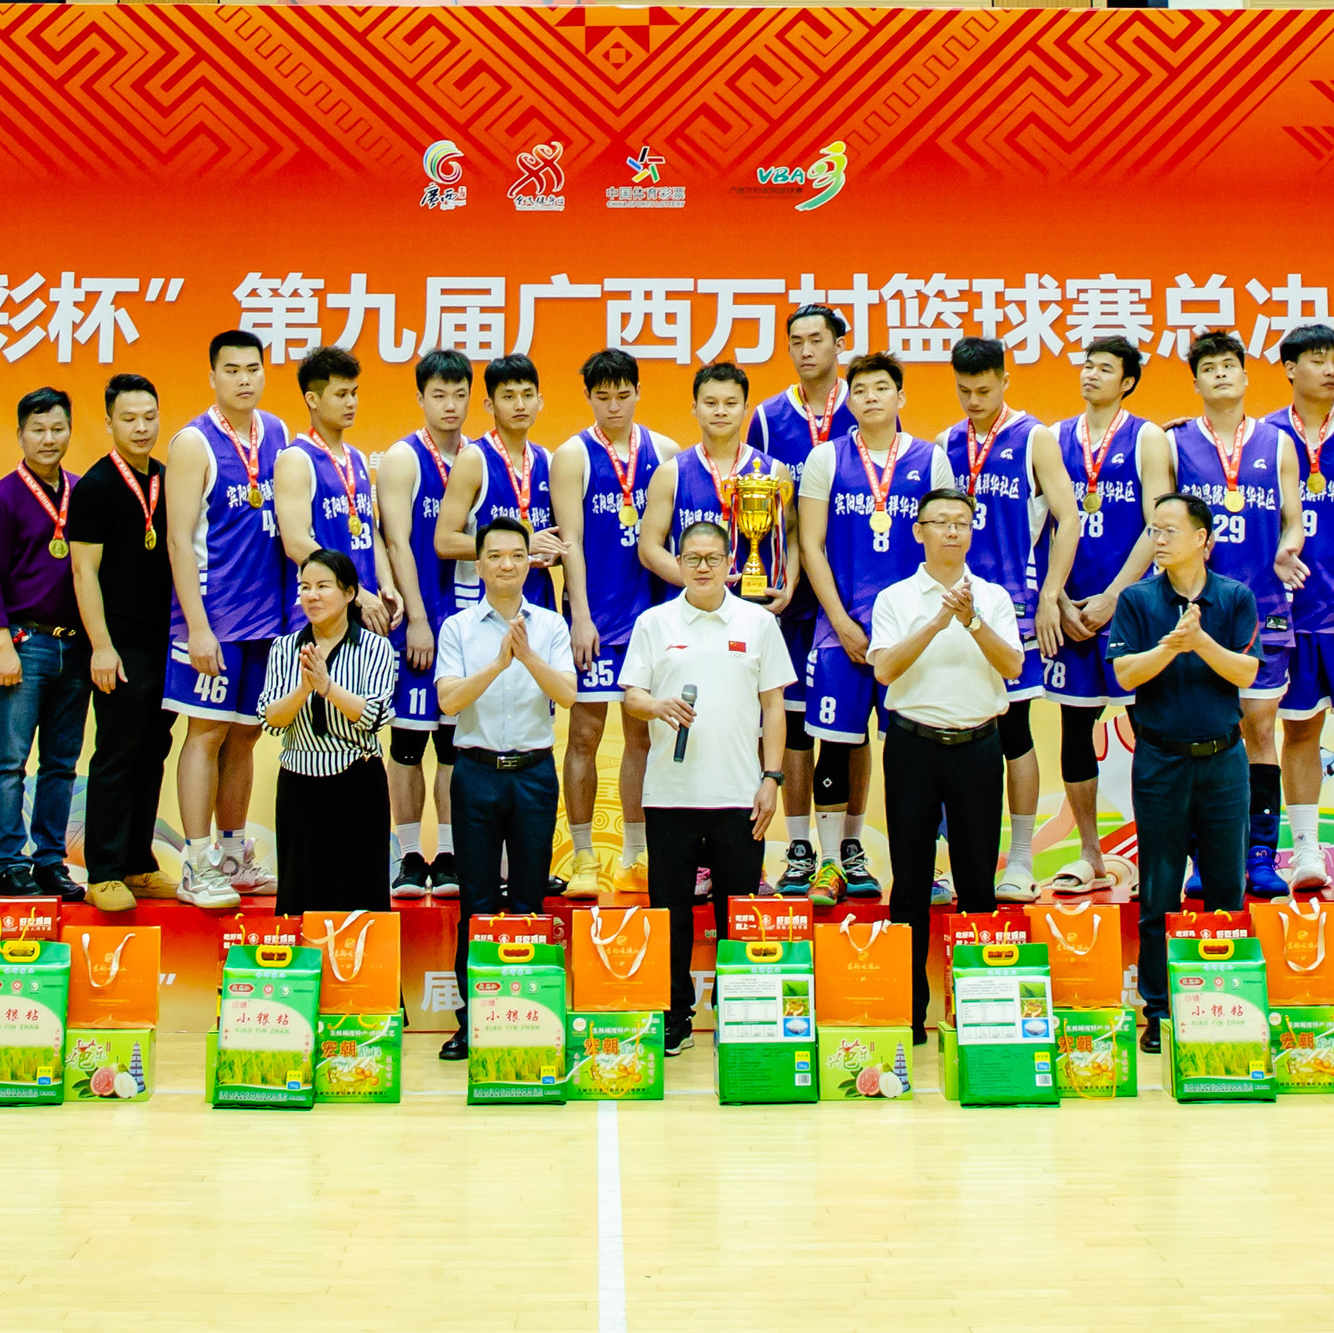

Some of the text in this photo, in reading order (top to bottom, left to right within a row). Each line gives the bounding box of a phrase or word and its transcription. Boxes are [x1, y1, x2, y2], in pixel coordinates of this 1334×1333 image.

[757, 167, 805, 184] VBA
[606, 187, 686, 200] 中国体育彩票
[873, 527, 890, 553] 8
[1213, 514, 1246, 543] 29
[582, 659, 614, 688] 35
[194, 674, 229, 703] 46
[409, 688, 428, 714] 11
[819, 696, 837, 724] 8
